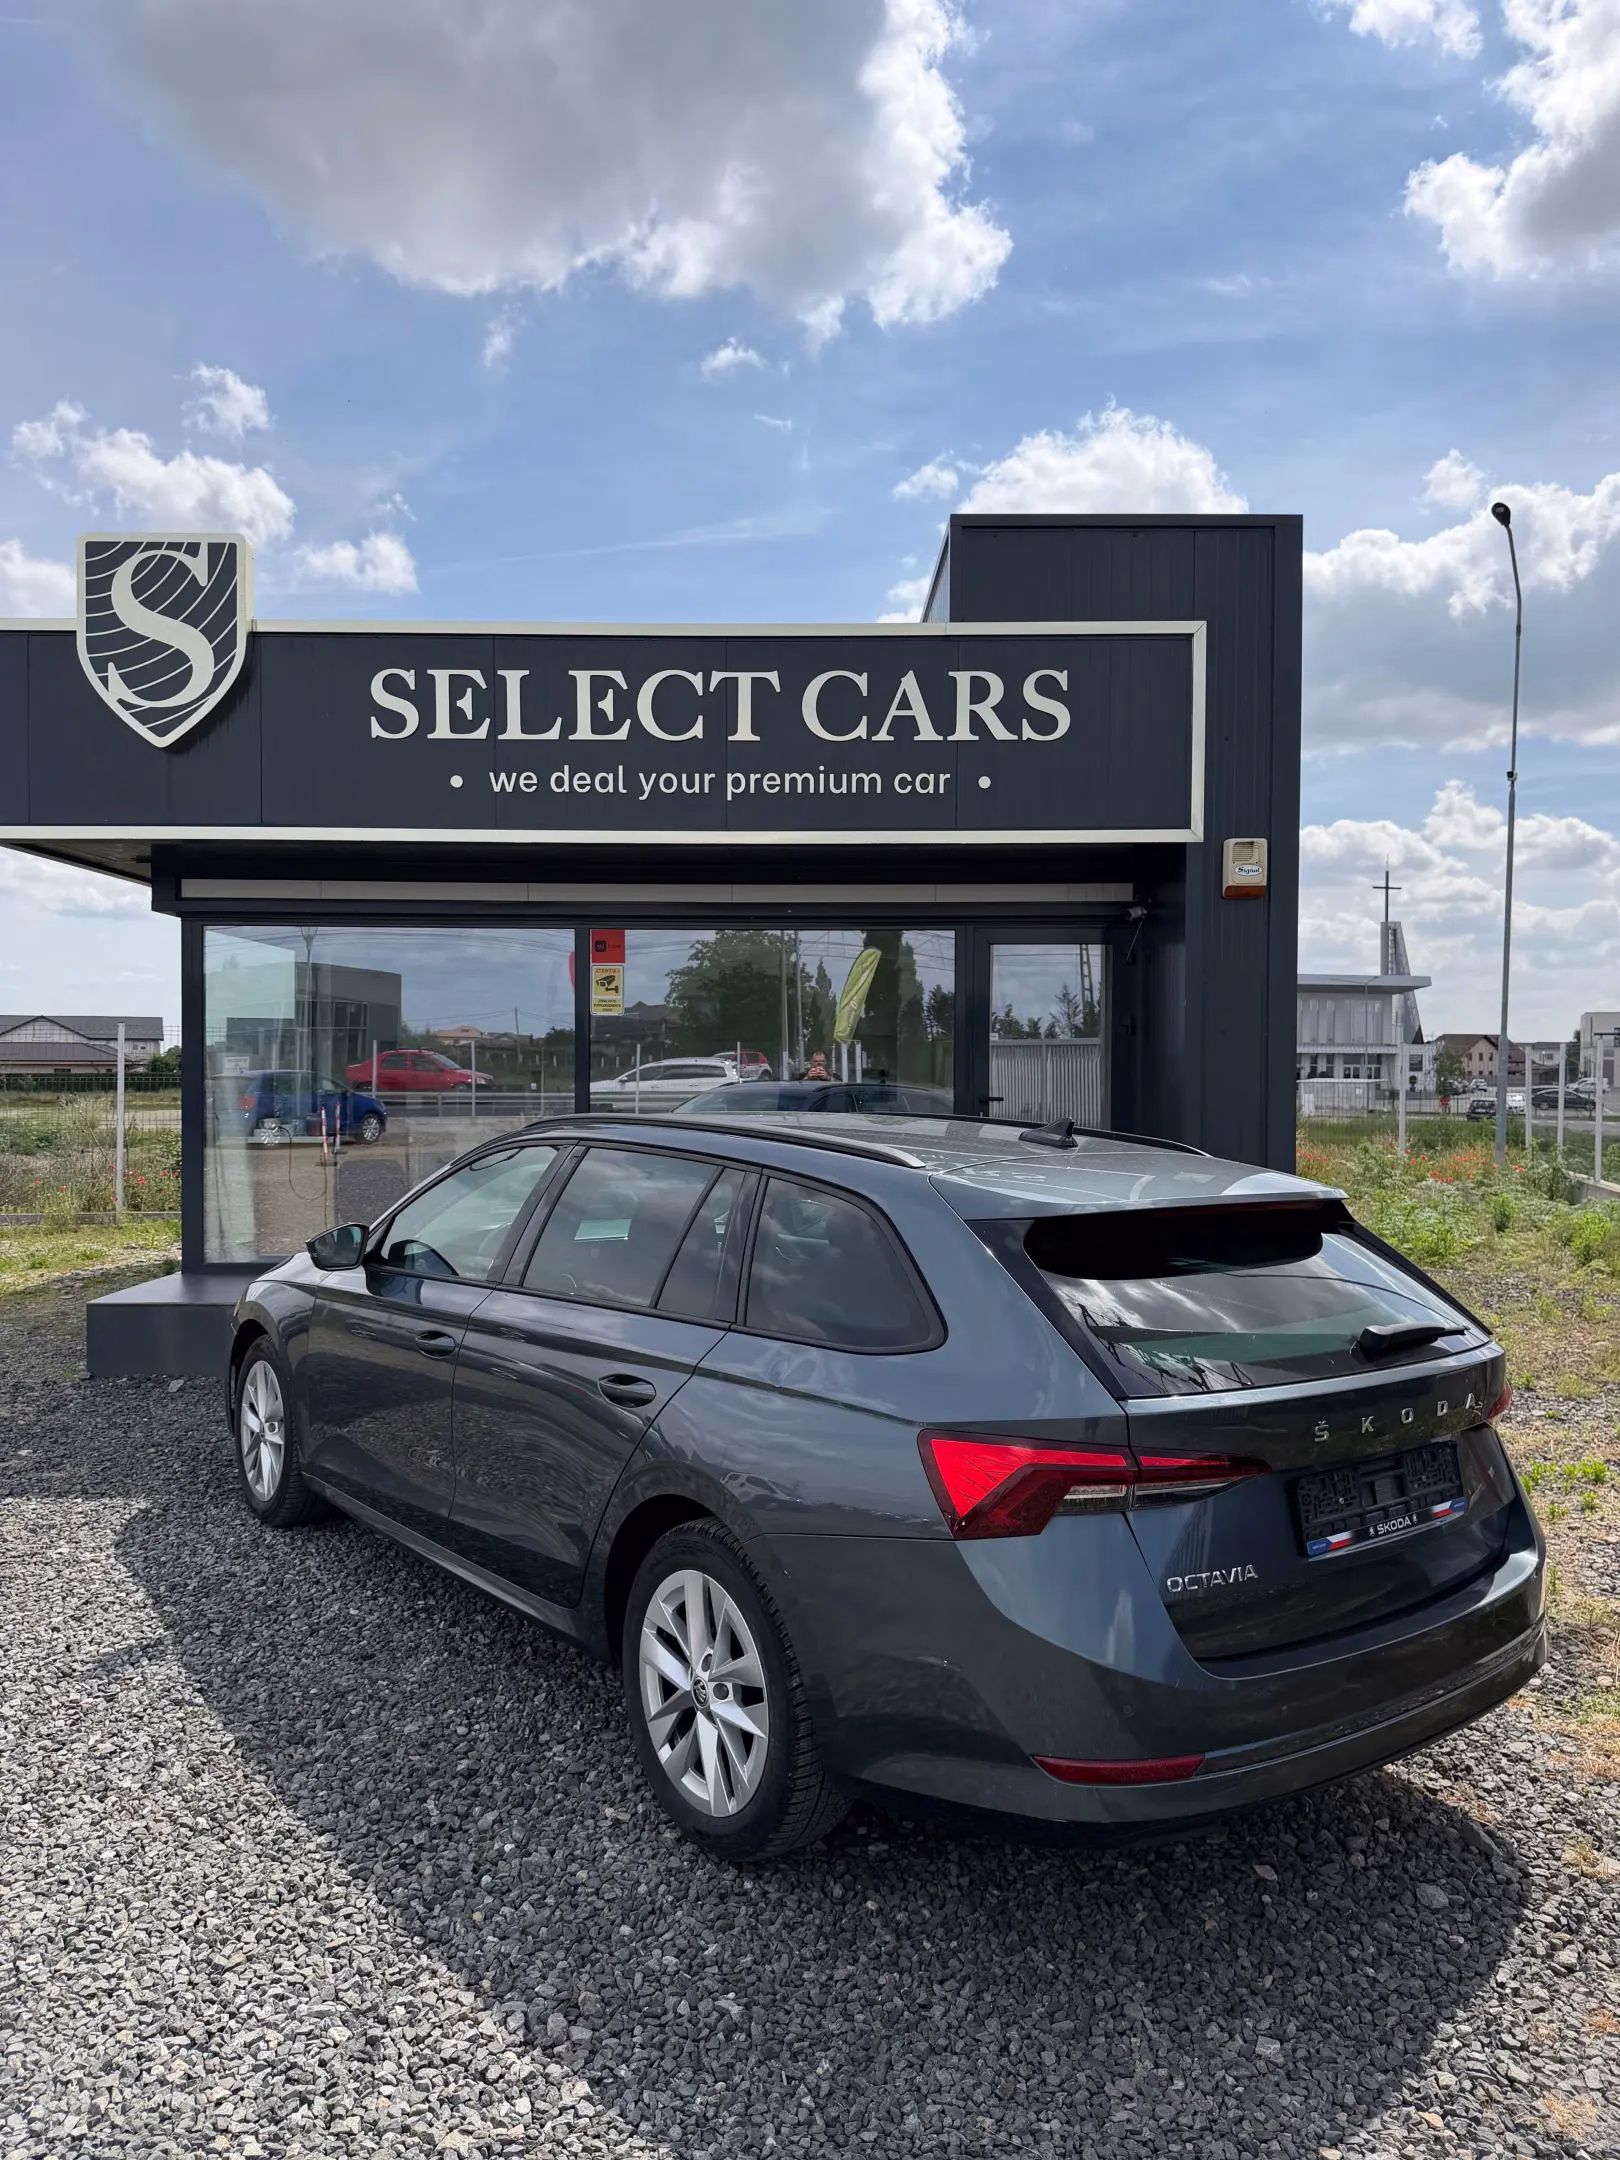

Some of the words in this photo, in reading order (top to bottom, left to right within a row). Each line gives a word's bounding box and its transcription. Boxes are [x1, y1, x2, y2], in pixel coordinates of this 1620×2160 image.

[370, 668, 781, 741] SELECT
[801, 669, 1071, 742] CARS
[488, 771, 538, 794] we
[550, 764, 628, 794] deal
[638, 772, 716, 801] your
[726, 765, 882, 801] premium
[893, 772, 951, 794] car
[1314, 1392, 1478, 1442] ŠKODA
[1166, 1564, 1259, 1593] OCTAVIA
